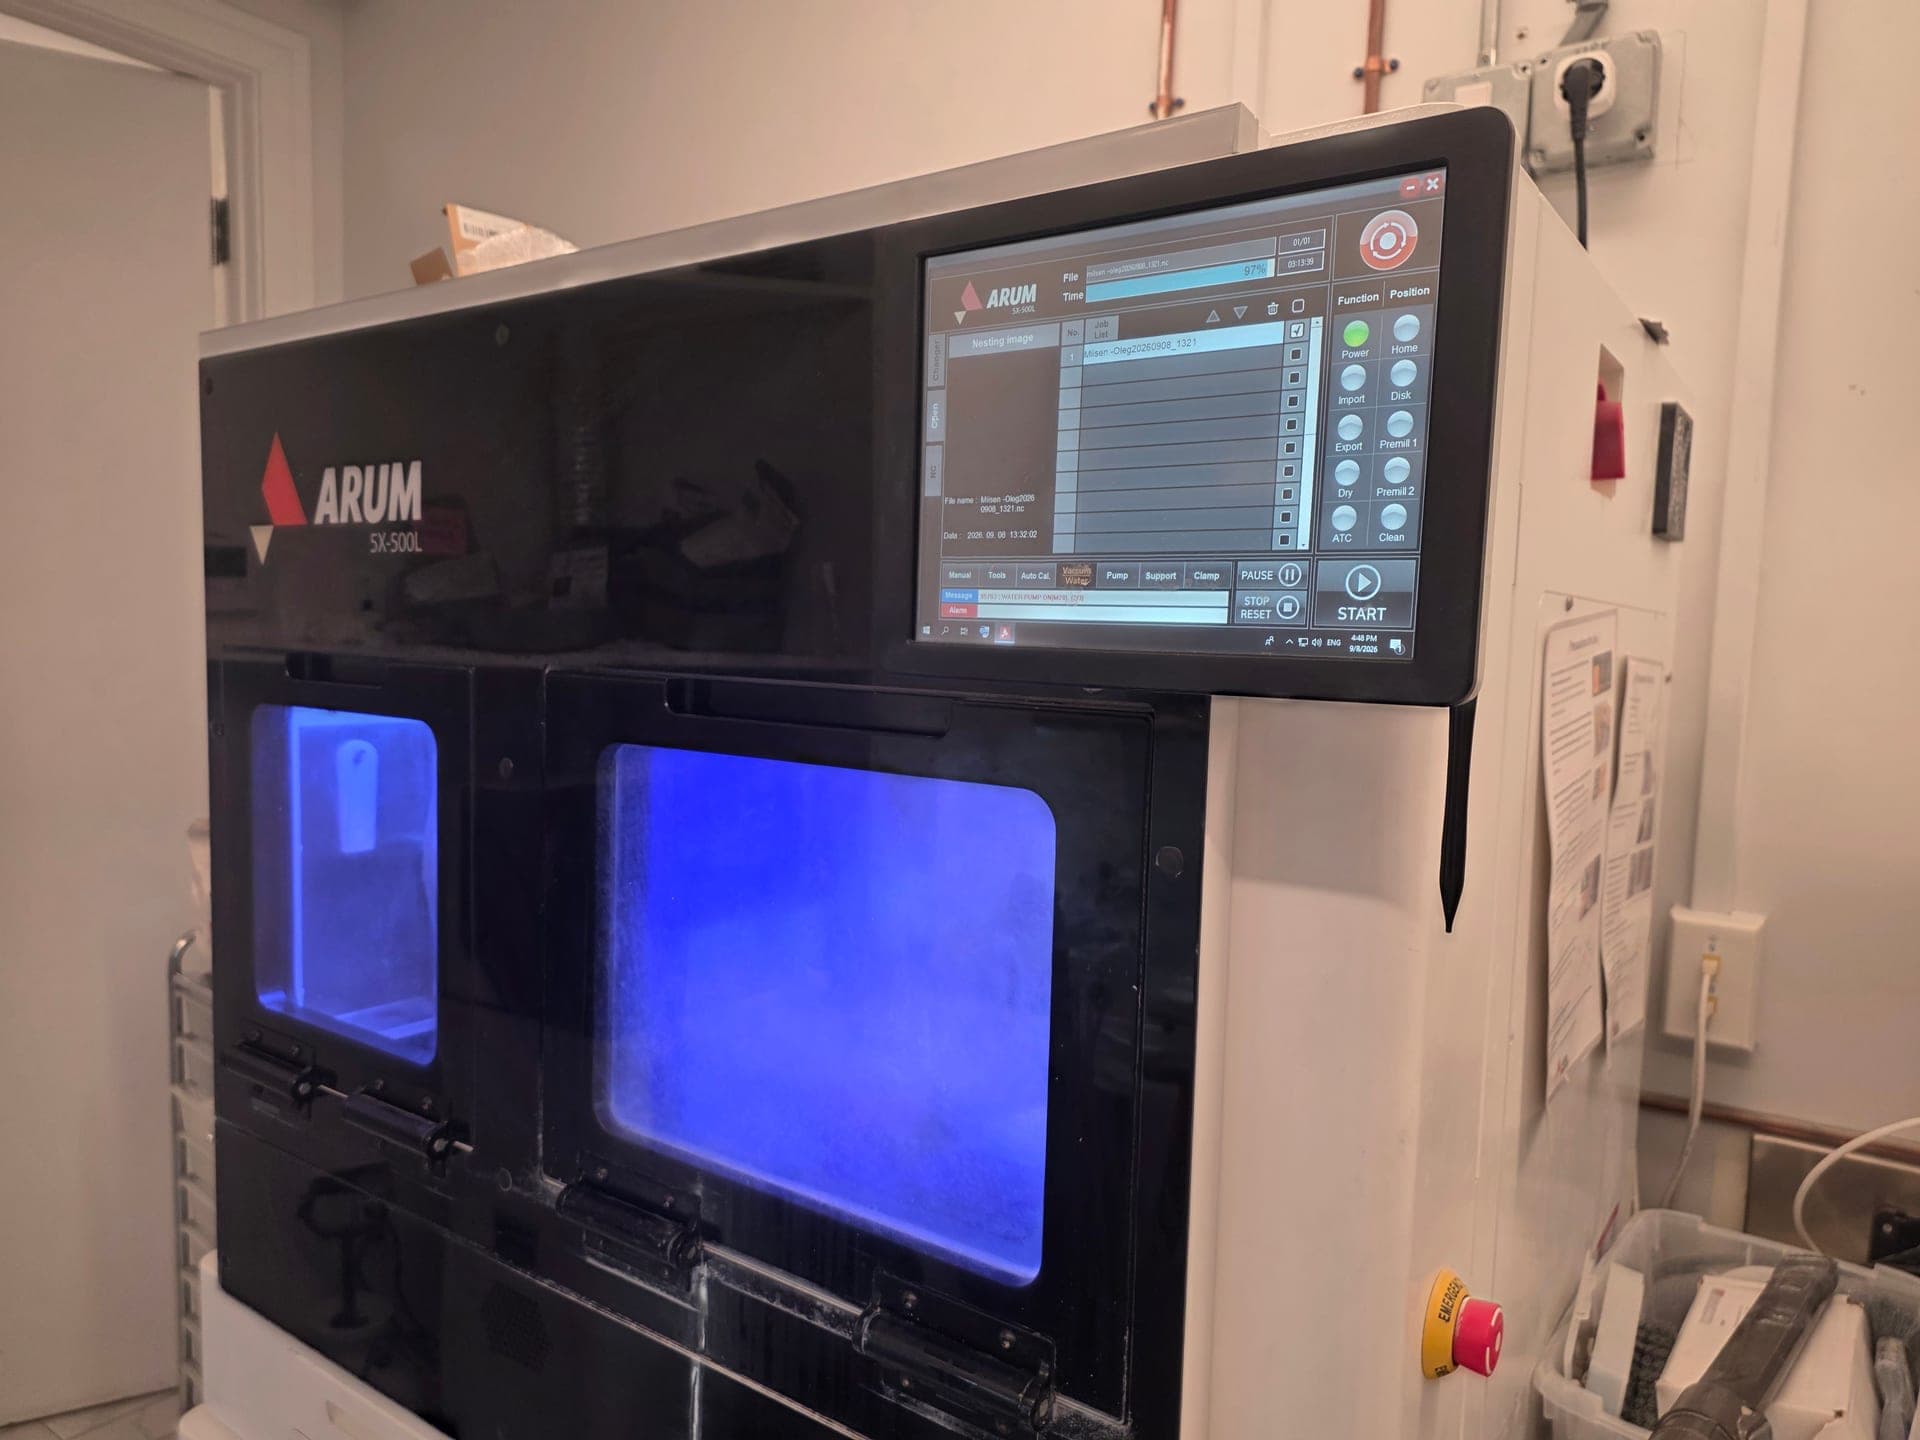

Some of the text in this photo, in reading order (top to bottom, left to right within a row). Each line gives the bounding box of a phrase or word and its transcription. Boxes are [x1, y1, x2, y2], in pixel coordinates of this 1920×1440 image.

[1293, 237, 1310, 247] 01/01
[1244, 264, 1266, 276] 97%
[1063, 272, 1079, 283] File
[986, 283, 1037, 309] ARUM
[1063, 291, 1084, 302] Time
[1389, 287, 1430, 299] Position
[1338, 293, 1380, 305] Function
[1012, 305, 1035, 315] SX-500L
[1094, 320, 1109, 329] Job
[1067, 328, 1080, 337] No.
[1094, 331, 1109, 339] List
[972, 334, 1034, 349] Nesting image
[1342, 349, 1370, 359] Power
[1391, 344, 1418, 354] Home
[1338, 394, 1365, 406] Import
[1391, 391, 1411, 401] Disk
[1335, 442, 1363, 453] Export
[1379, 439, 1410, 449] Premill
[930, 465, 937, 478] NC
[313, 460, 424, 525] ARUM
[1338, 488, 1354, 499] Dry
[1376, 486, 1415, 497] Premill 2
[1010, 530, 1038, 538] 13:32:02
[1332, 533, 1352, 543] ATC
[1379, 532, 1405, 542] Clean
[369, 531, 424, 554] SX-500L
[988, 571, 1007, 579] Tools
[1021, 571, 1051, 580] Auto Cal.
[1106, 571, 1129, 580] Pump
[1145, 571, 1177, 581] Support
[1193, 571, 1220, 581] Clamp
[1241, 570, 1273, 581] PAUSE
[945, 592, 973, 600] Message
[1243, 596, 1270, 606] STOP
[949, 606, 967, 614] Alarm
[1241, 609, 1272, 619] RESET
[1337, 607, 1387, 621] START
[1327, 638, 1341, 646] ENG
[1349, 644, 1378, 653] 9/8/2026
